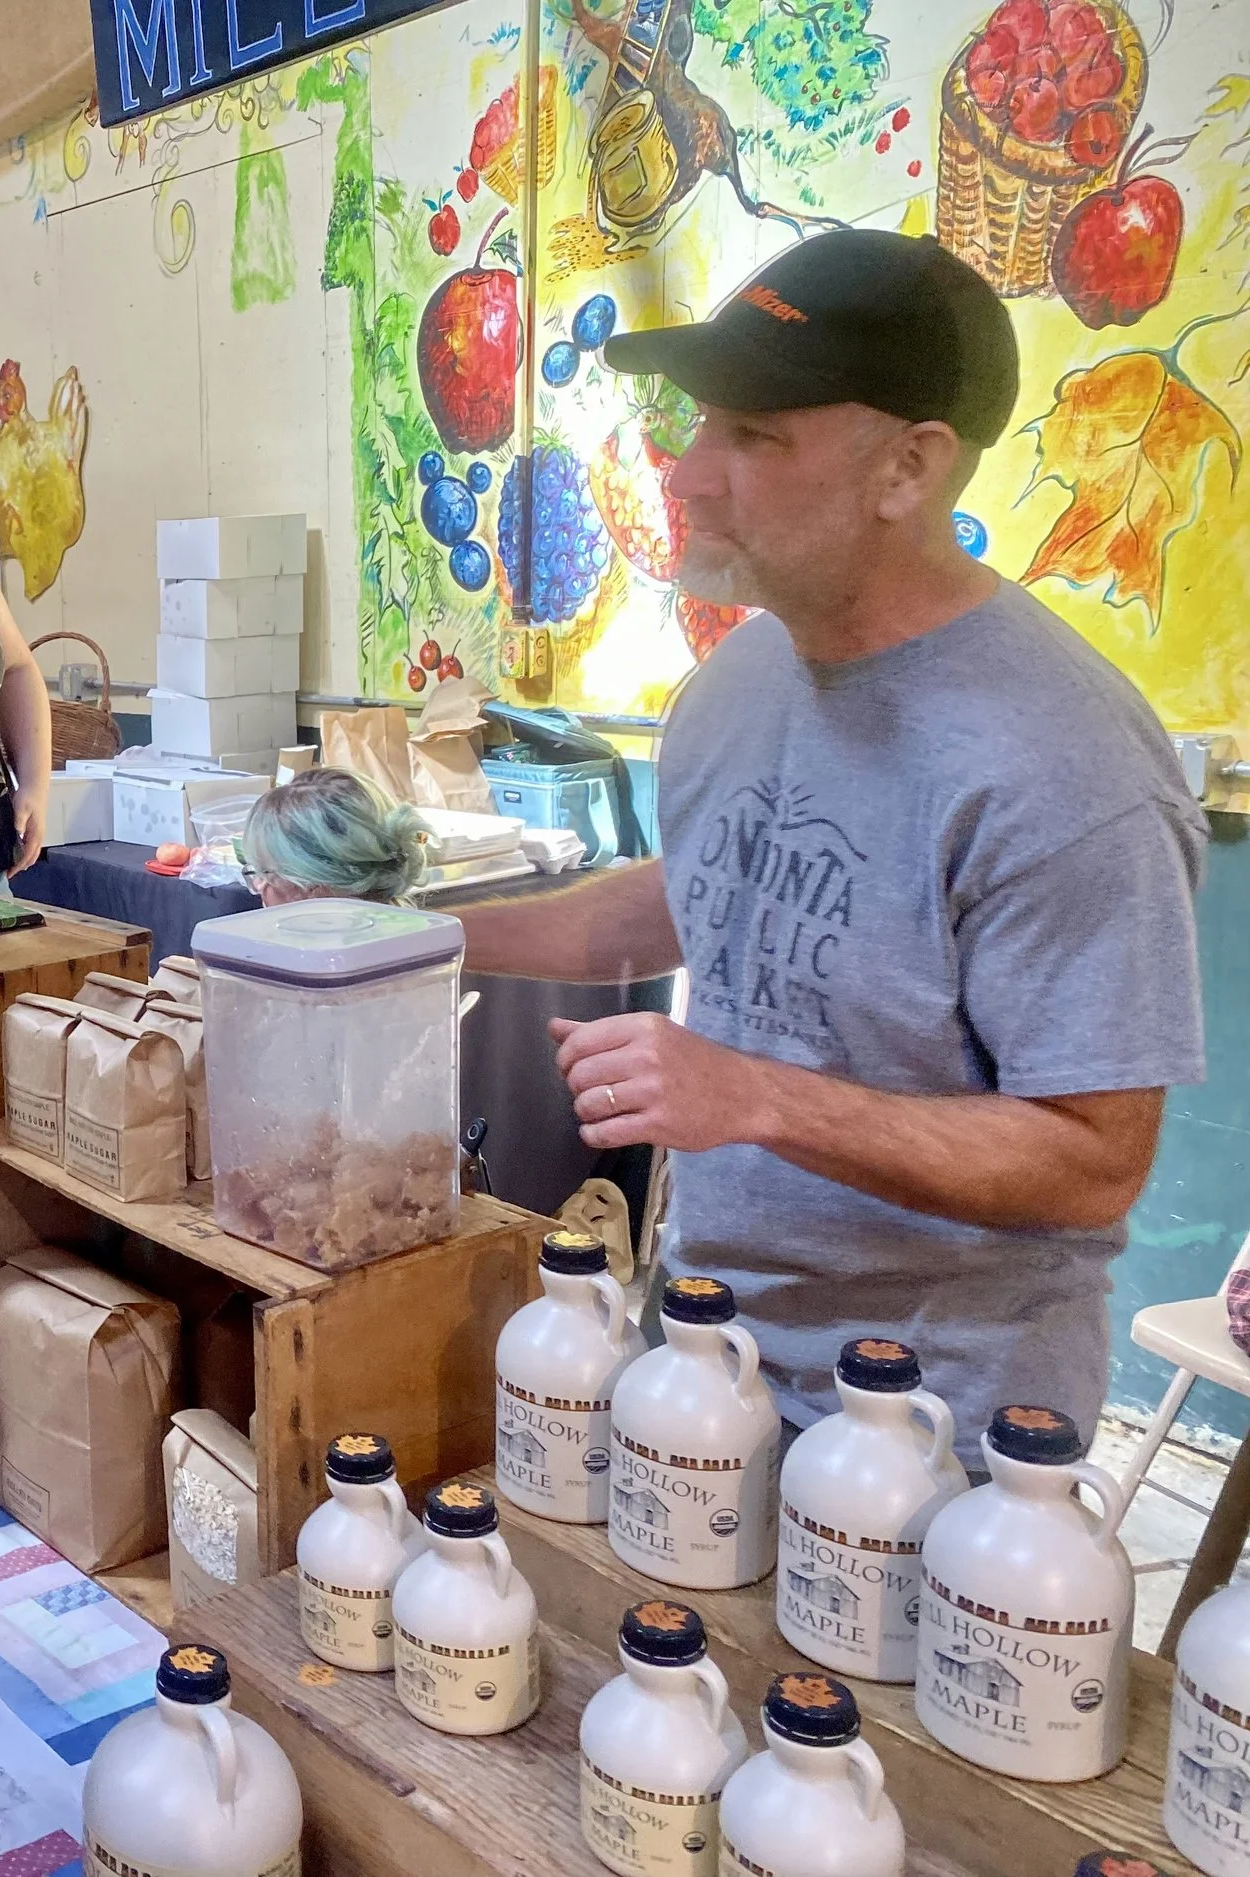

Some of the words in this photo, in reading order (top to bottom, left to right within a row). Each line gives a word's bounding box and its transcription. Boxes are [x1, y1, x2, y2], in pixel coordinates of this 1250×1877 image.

[684, 875, 839, 980] PULIC
[28, 1115, 57, 1131] SUGAR
[89, 1143, 118, 1162] SUGAR
[504, 1400, 590, 1446] HOLLOW
[621, 1453, 717, 1507] HOLLOW
[613, 1508, 675, 1553] MAPLE
[801, 1535, 913, 1593] HOLLOW
[786, 1594, 866, 1645] MAPLE
[953, 1615, 1081, 1678] HOLLOW
[931, 1678, 1027, 1733] MAPLE
[1176, 1781, 1250, 1846] MAPL
